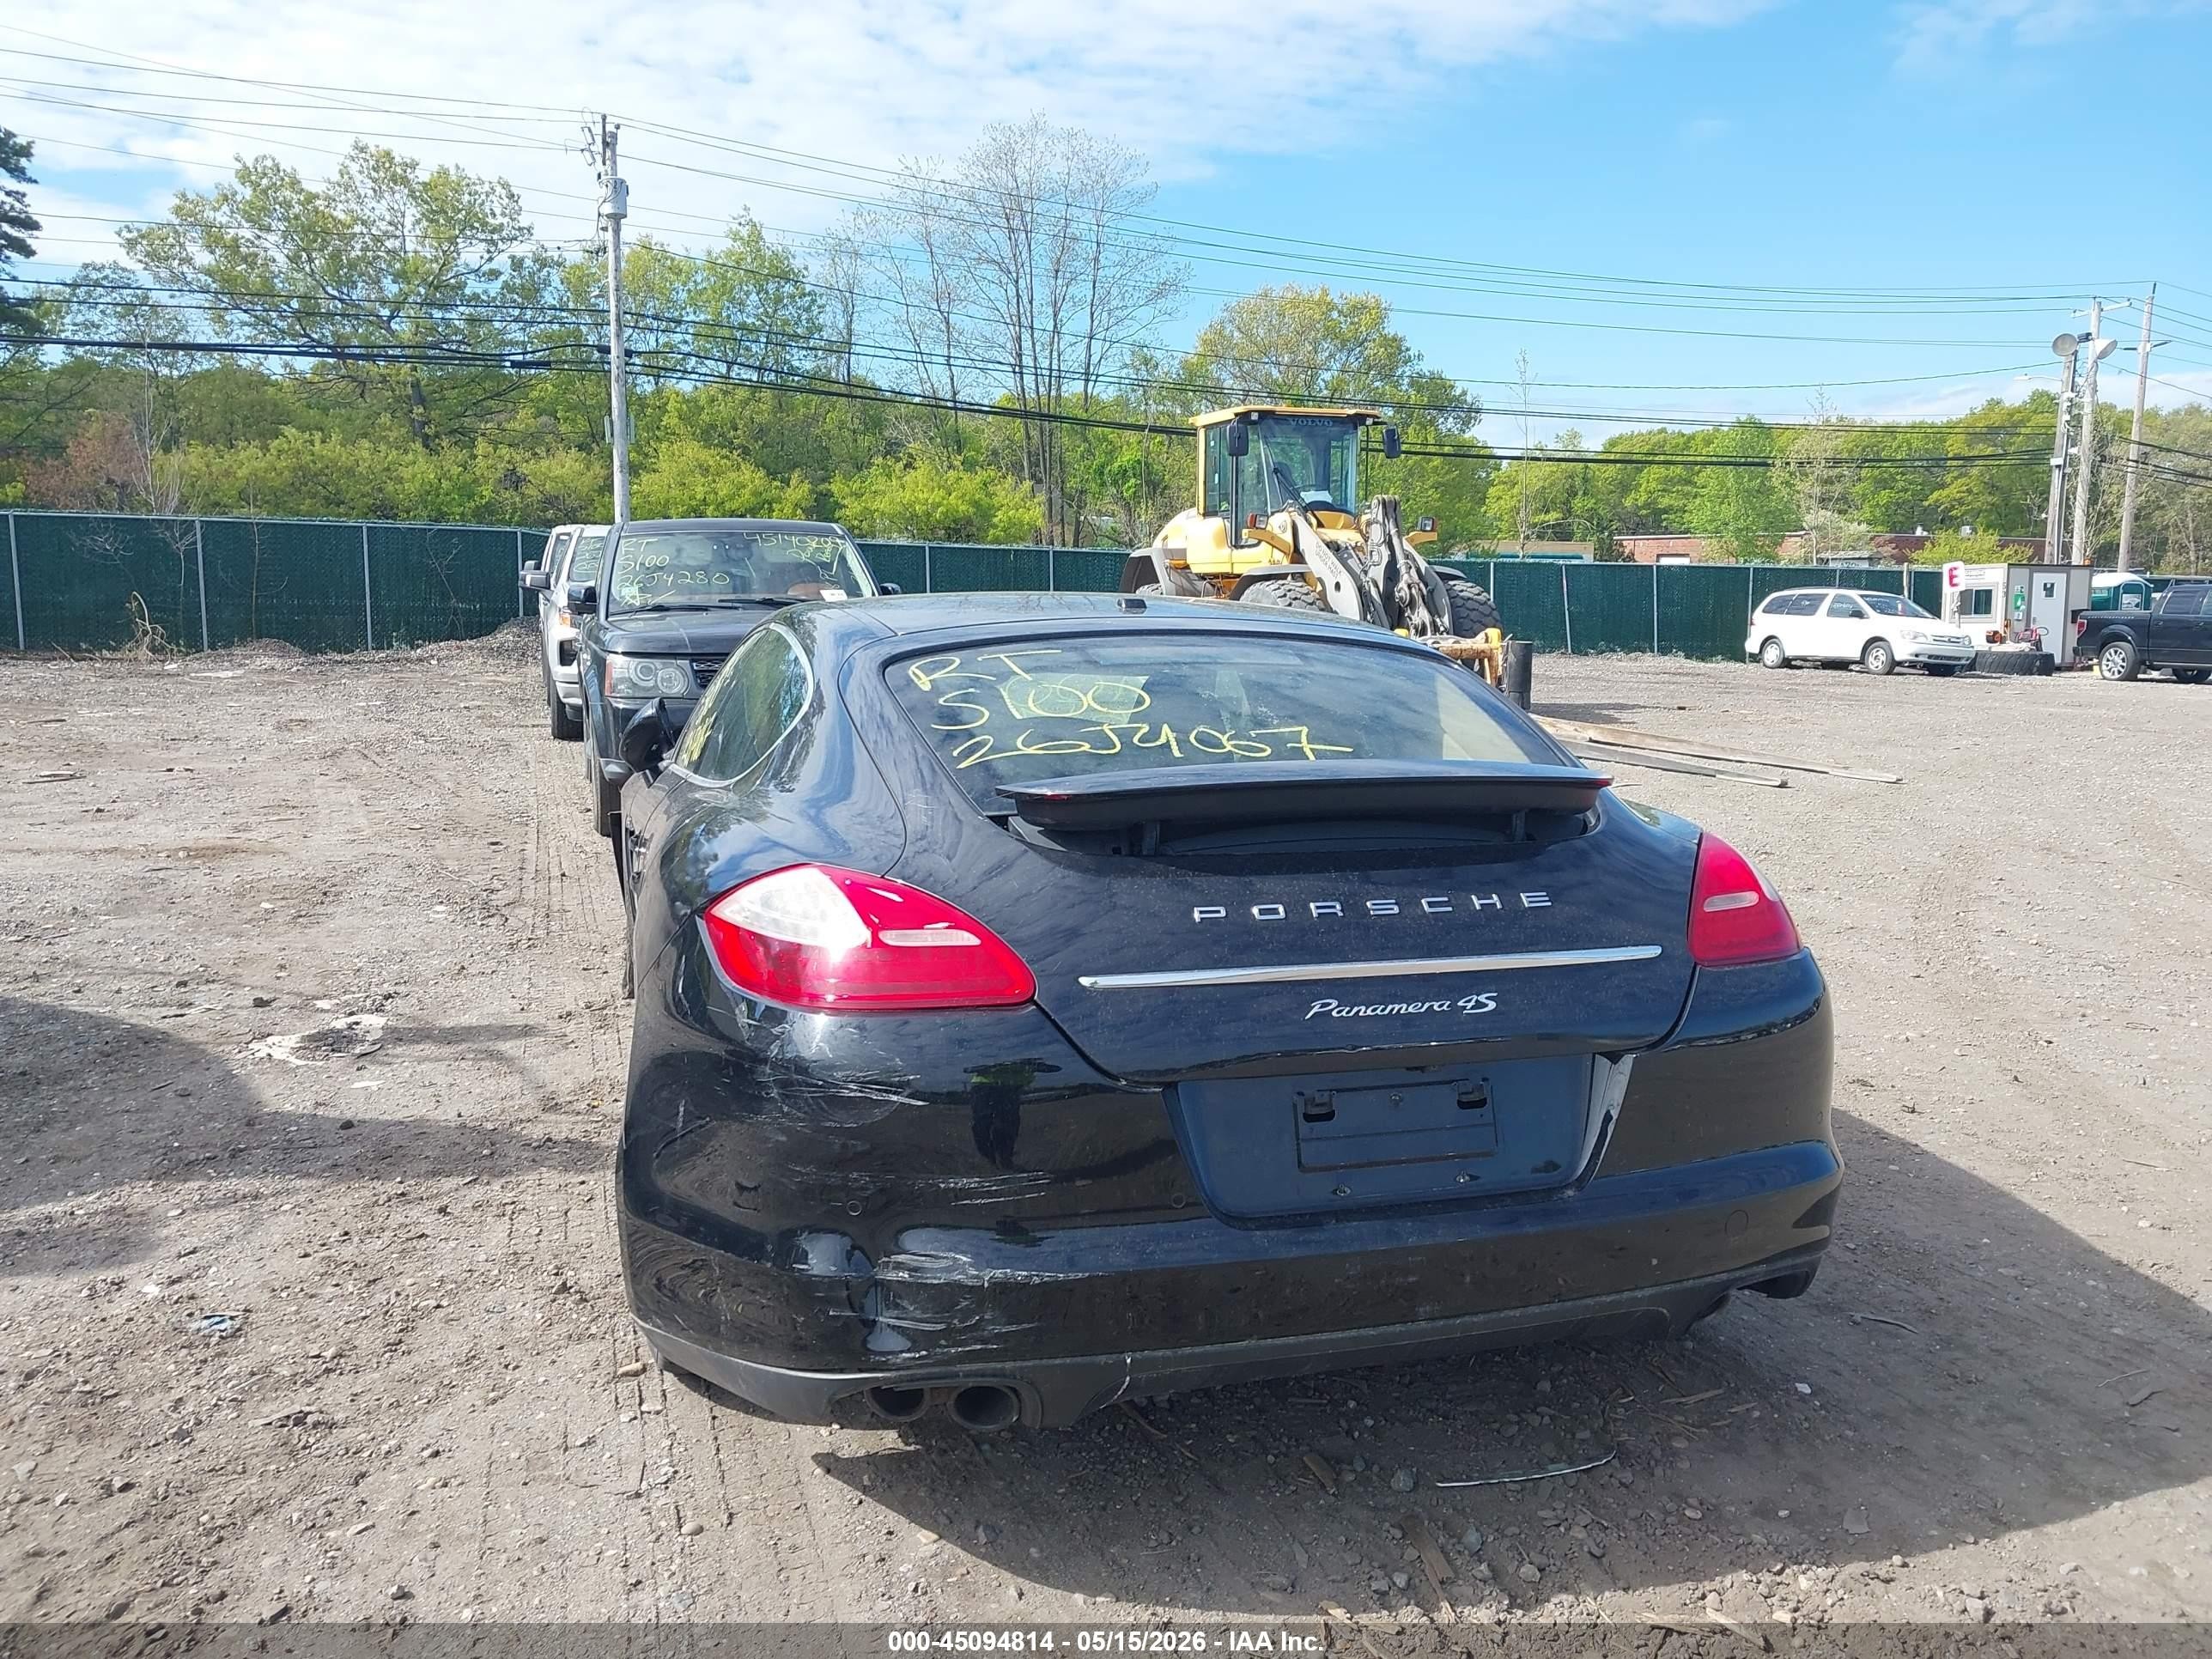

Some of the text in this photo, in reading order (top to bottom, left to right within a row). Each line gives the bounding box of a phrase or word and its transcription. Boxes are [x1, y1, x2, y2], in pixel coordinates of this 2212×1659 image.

[1290, 418, 1334, 427] VOLVO
[622, 538, 659, 555] RT
[1948, 567, 1960, 587] E
[908, 649, 1062, 692] RT
[1194, 891, 1552, 922] PORSCHE
[1304, 992, 1498, 1021] Panamera 4S
